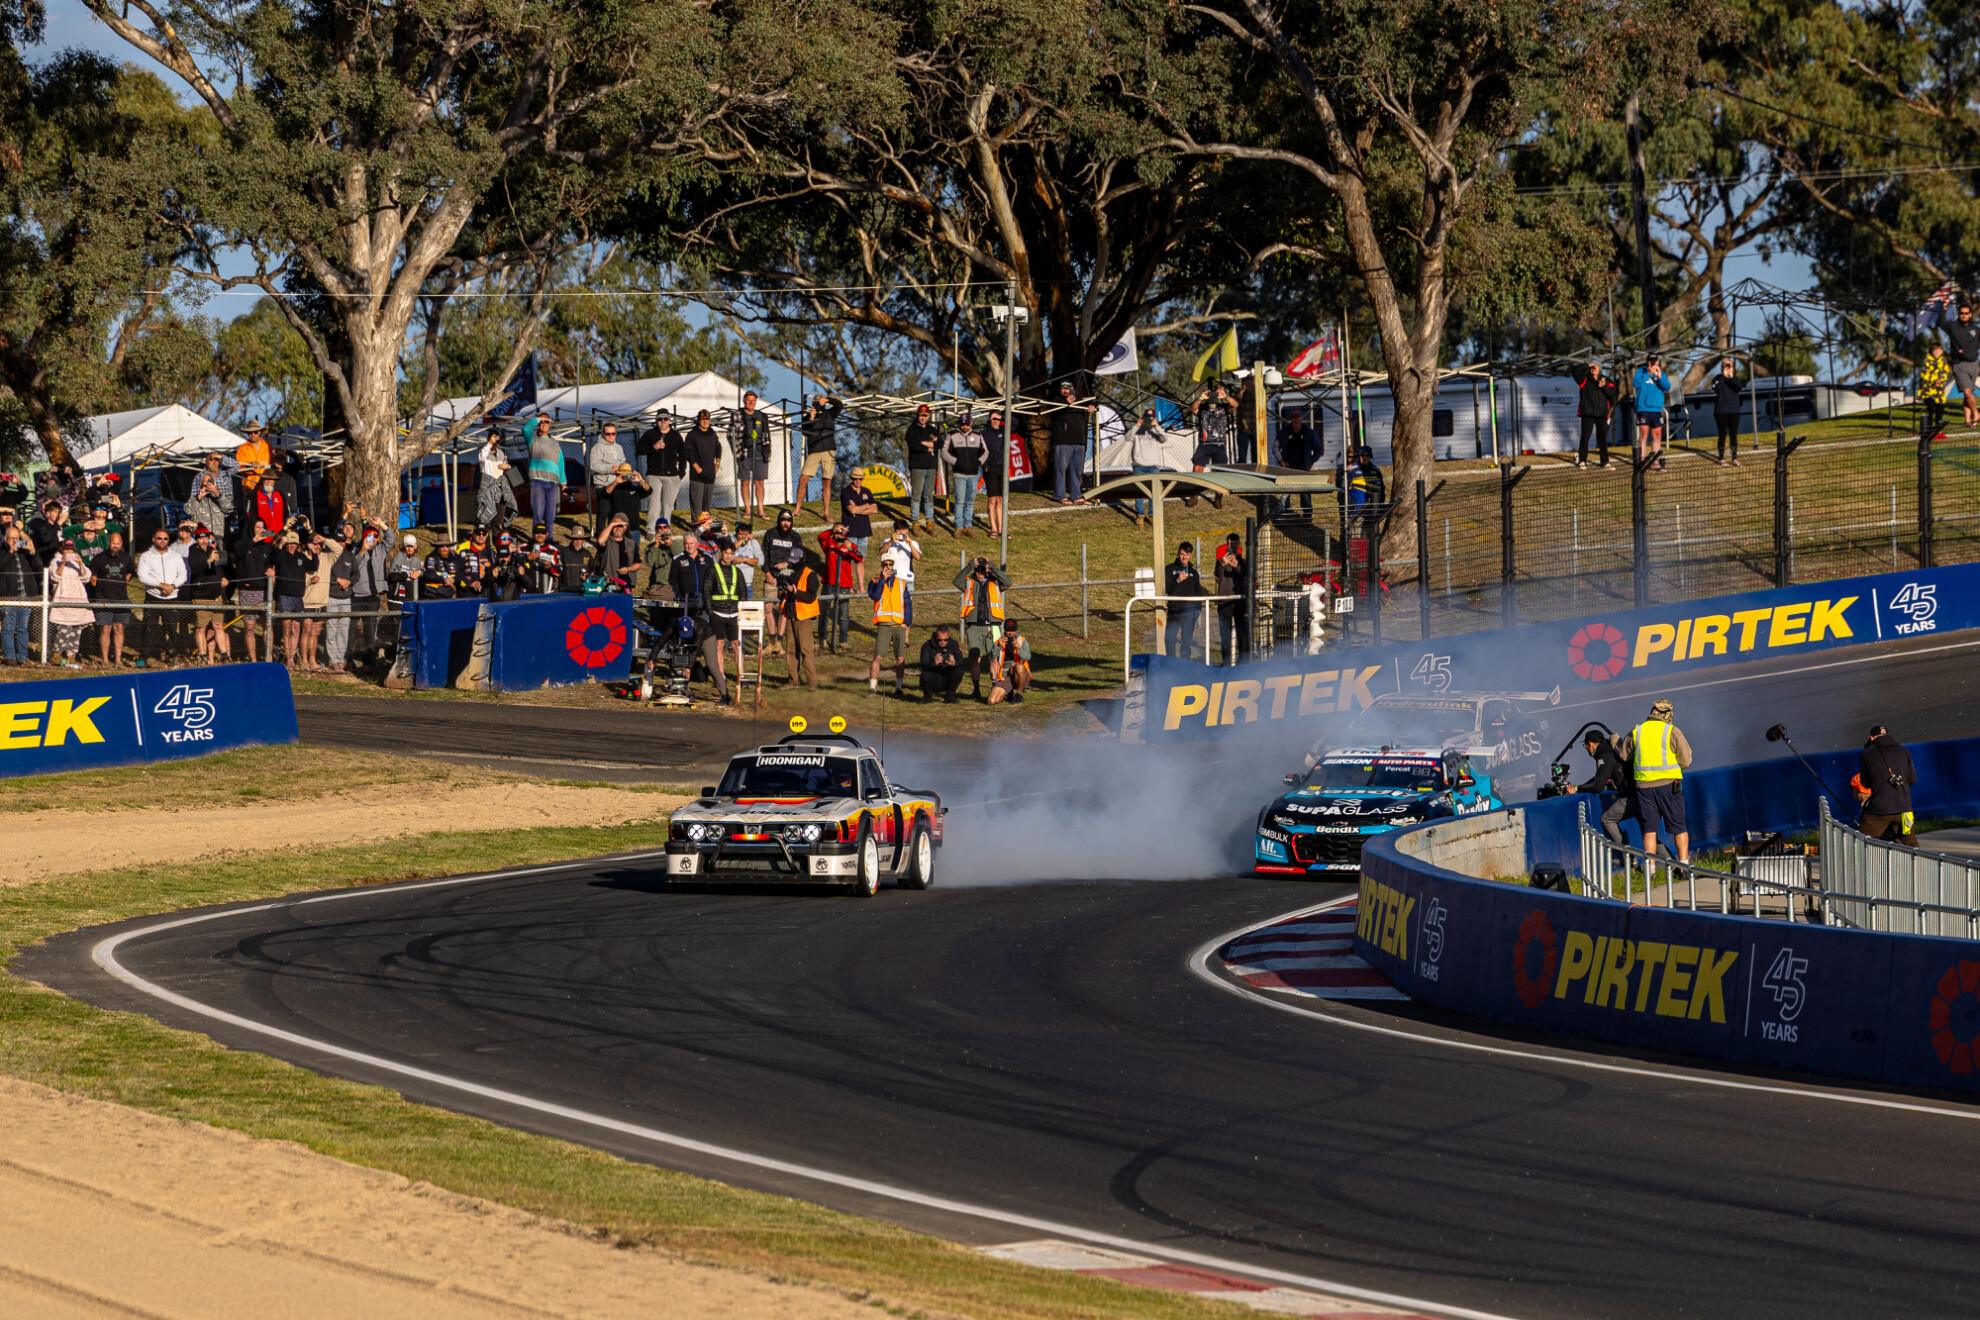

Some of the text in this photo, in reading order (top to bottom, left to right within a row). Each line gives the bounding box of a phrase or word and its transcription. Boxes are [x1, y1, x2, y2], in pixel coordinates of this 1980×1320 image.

[869, 465, 904, 491] RACING
[1889, 582, 1937, 621] 45
[1632, 595, 1860, 668] PIRTEK
[1895, 619, 1936, 635] YEARS
[1410, 653, 1452, 693] 45
[154, 684, 216, 729] 45
[1163, 664, 1383, 731] PIRTEK
[1374, 700, 1473, 710] Hydraulink
[160, 728, 214, 743] YEARS
[1286, 803, 1410, 816] SUPAGLASS
[1315, 825, 1361, 834] Bendix
[1422, 896, 1448, 963] 45
[1419, 960, 1440, 982] YEARS
[1554, 930, 1740, 1025] PIRTEK
[1762, 947, 1809, 1022] 45
[1761, 1021, 1799, 1044] YEARS
